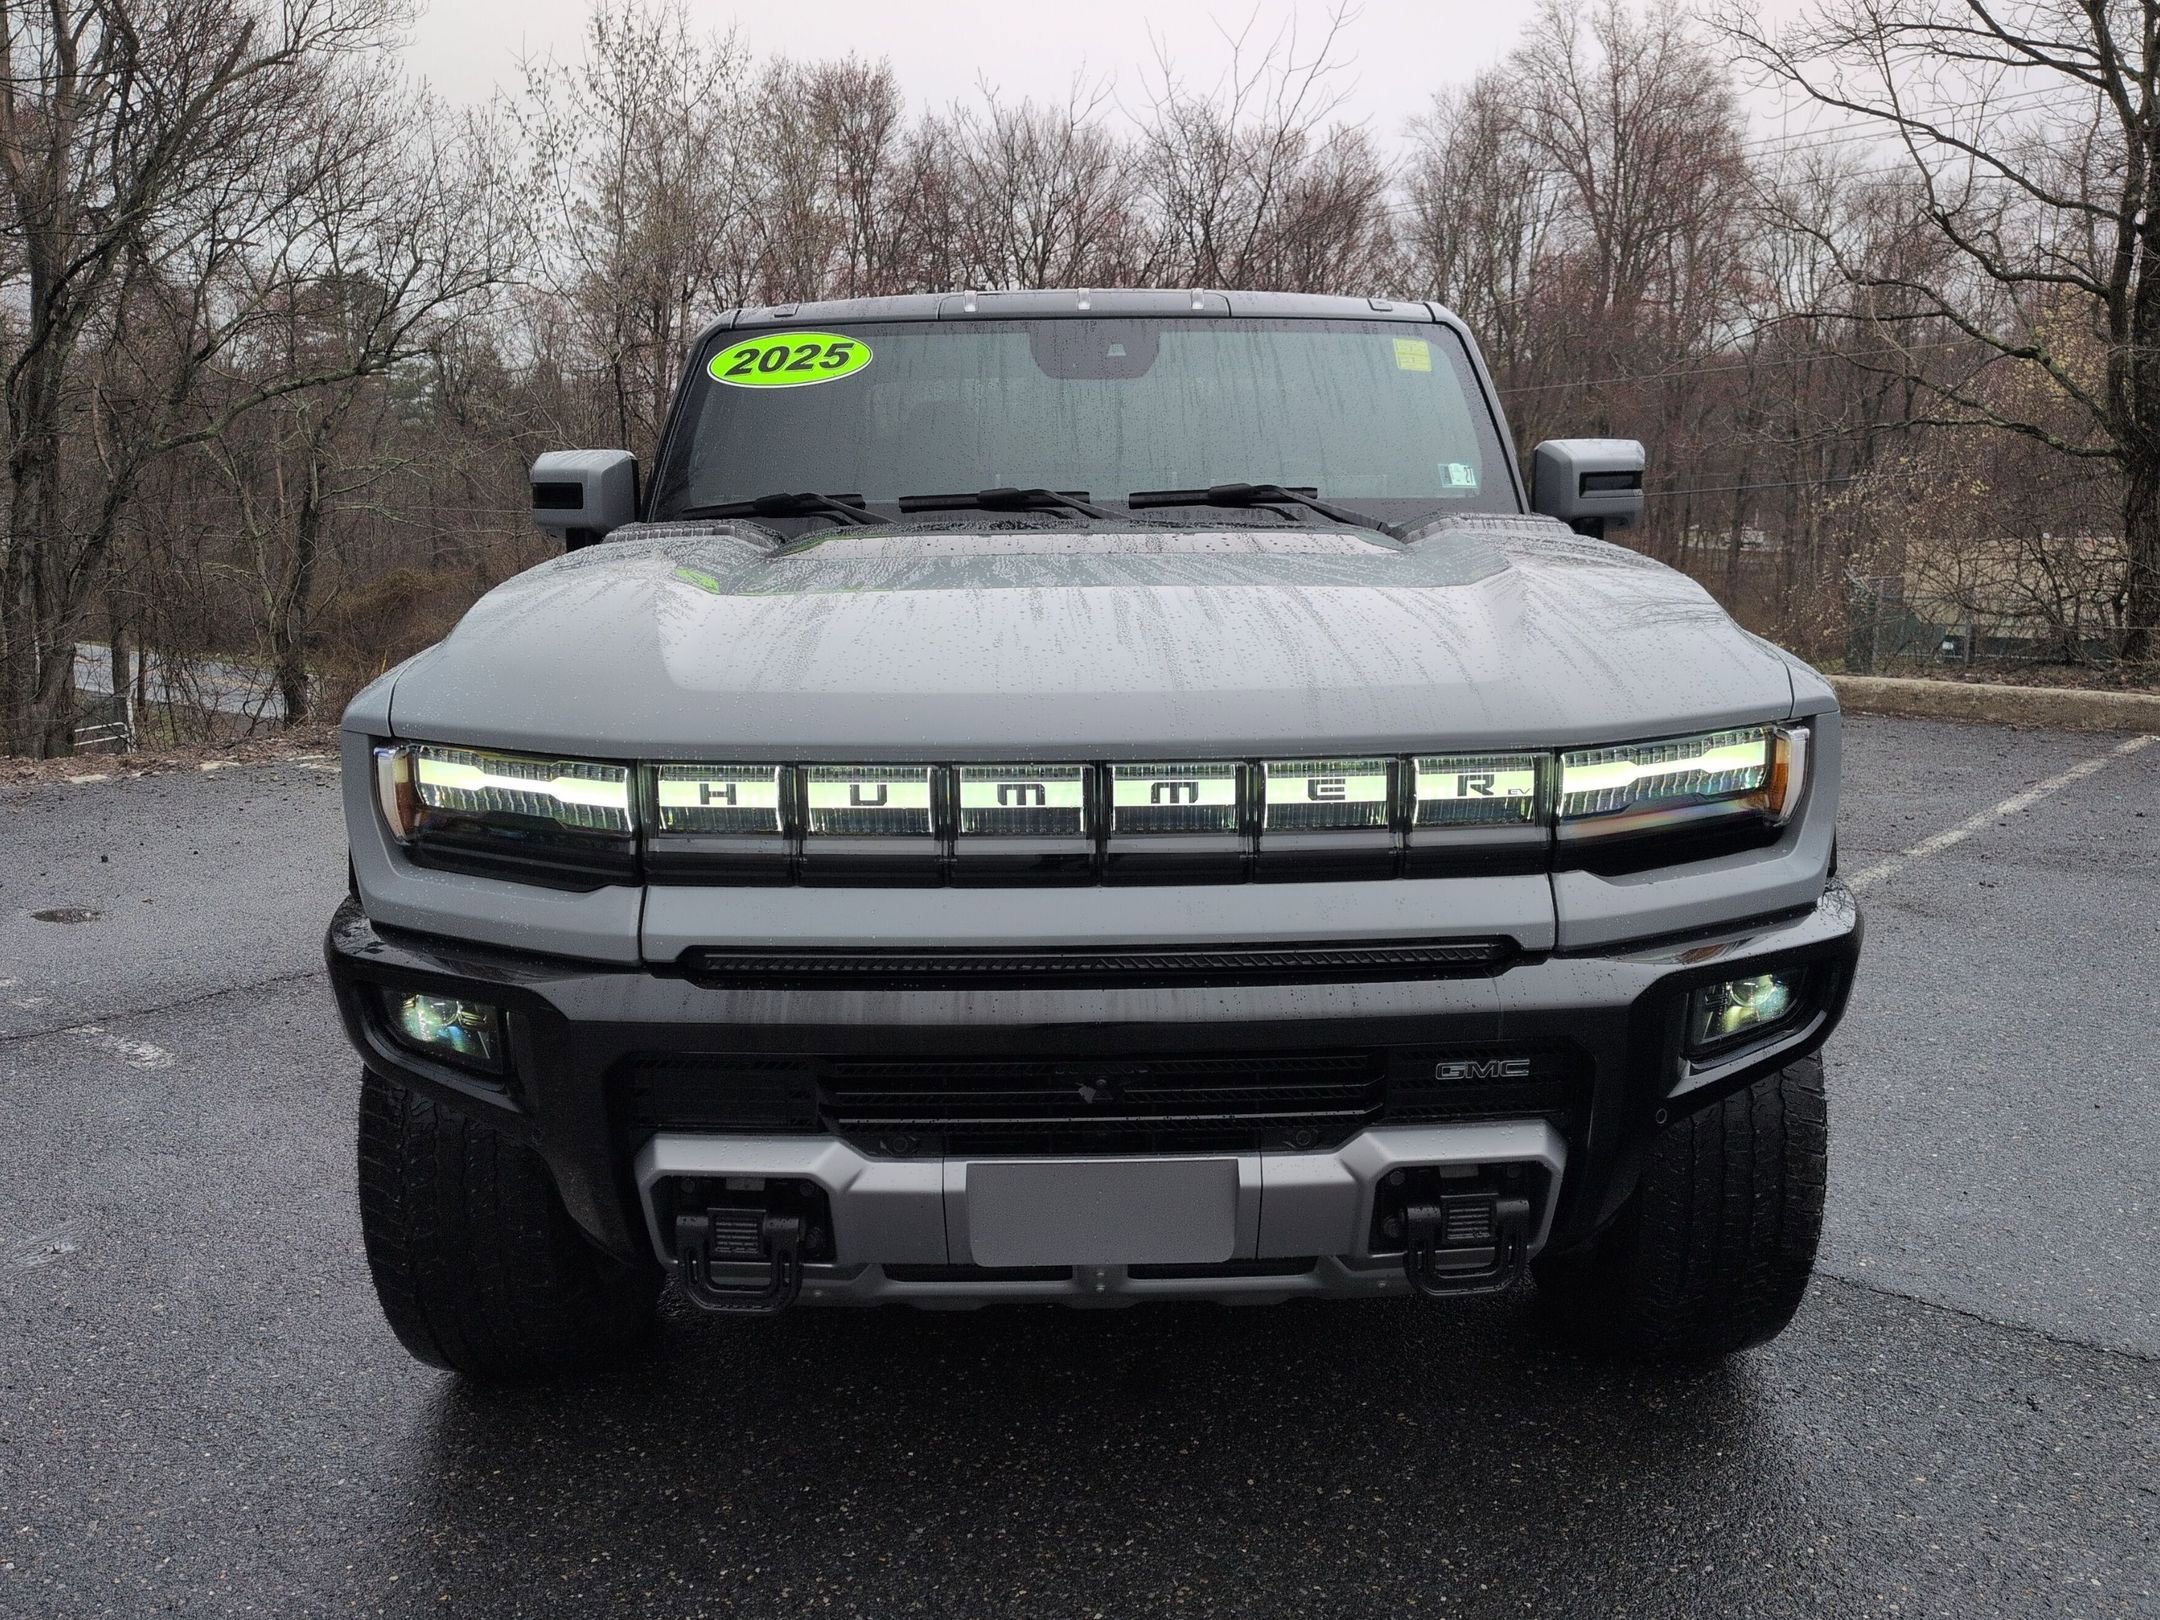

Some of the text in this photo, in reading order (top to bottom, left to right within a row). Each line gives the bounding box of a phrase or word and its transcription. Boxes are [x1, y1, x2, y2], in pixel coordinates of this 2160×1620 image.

[724, 342, 855, 376] 2025
[698, 773, 1531, 807] HUMMER EV
[1435, 1058, 1531, 1081] GMC
